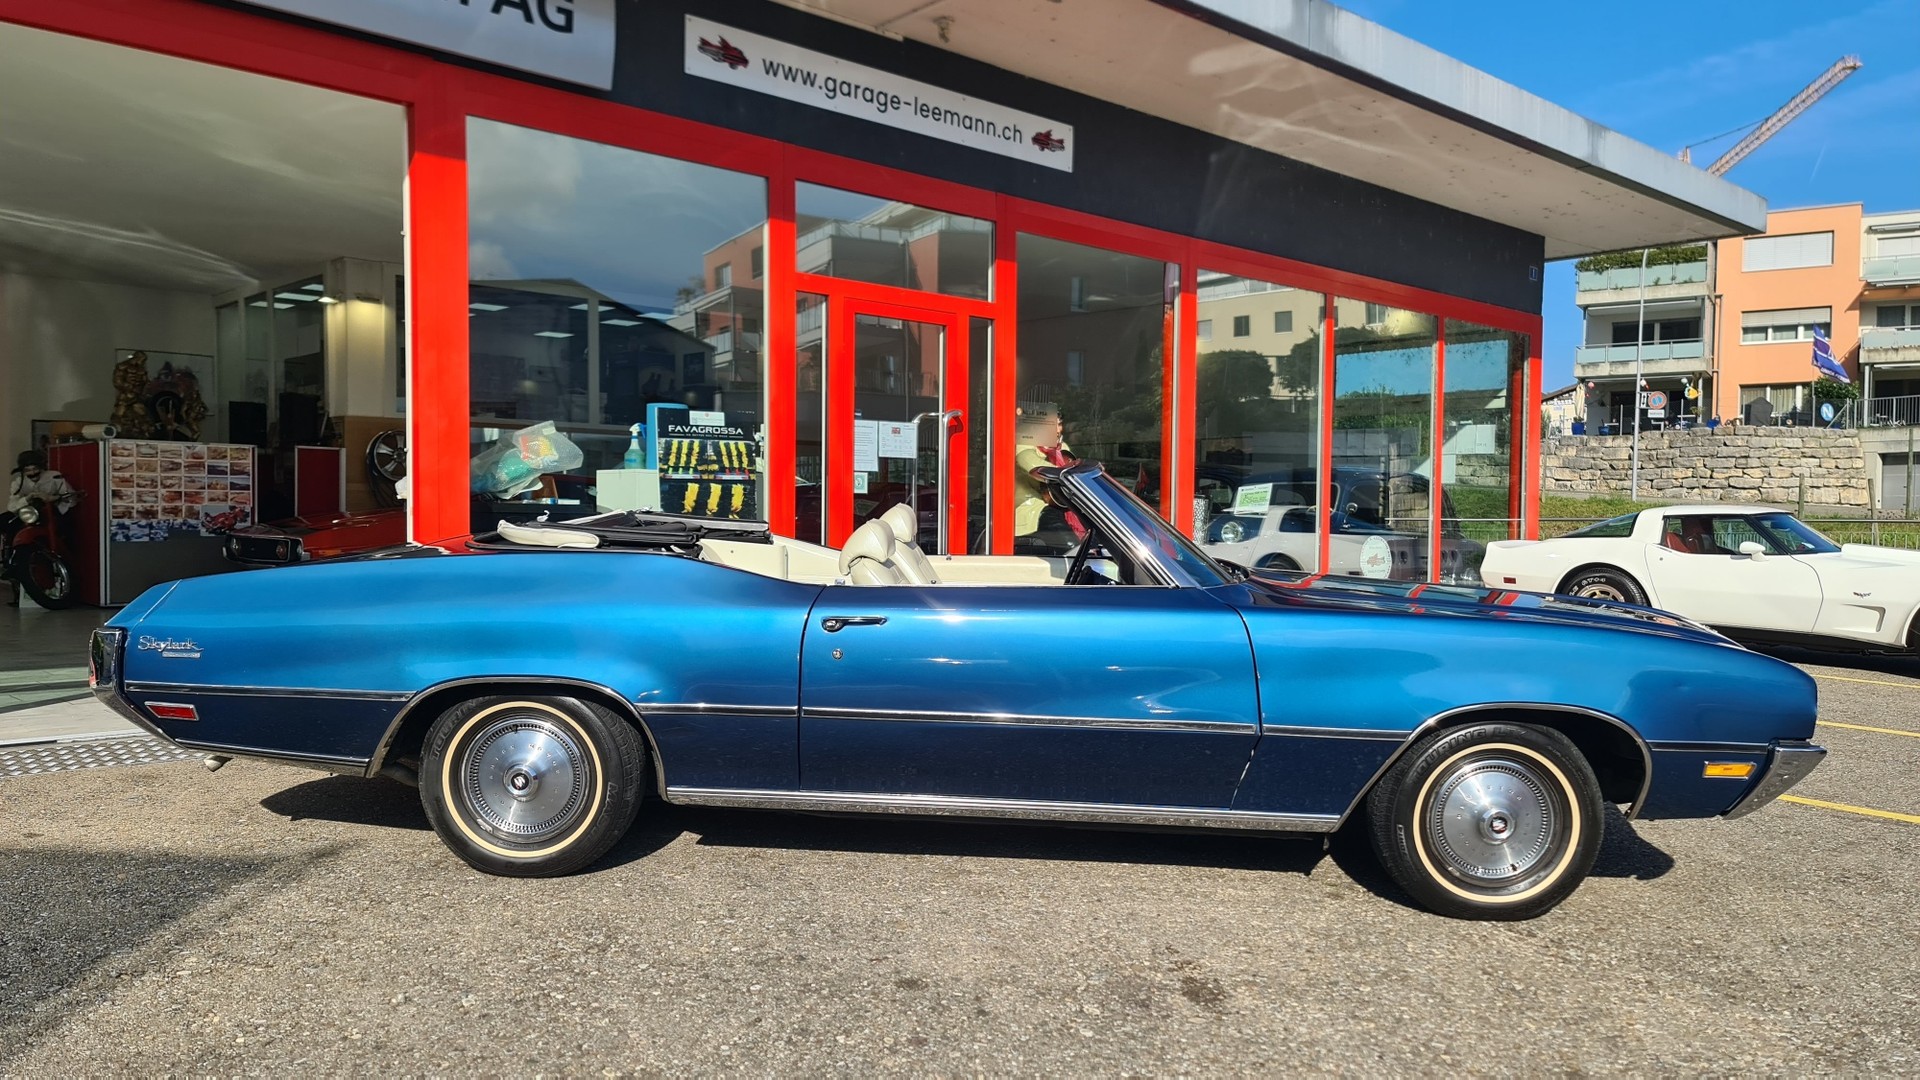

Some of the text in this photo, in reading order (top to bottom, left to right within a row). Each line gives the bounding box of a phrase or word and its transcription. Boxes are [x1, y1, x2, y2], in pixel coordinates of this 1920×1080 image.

[761, 58, 1023, 144] www.garage-leemann.ch
[668, 425, 743, 435] FAVAGROSSA
[138, 635, 204, 652] Skylark
